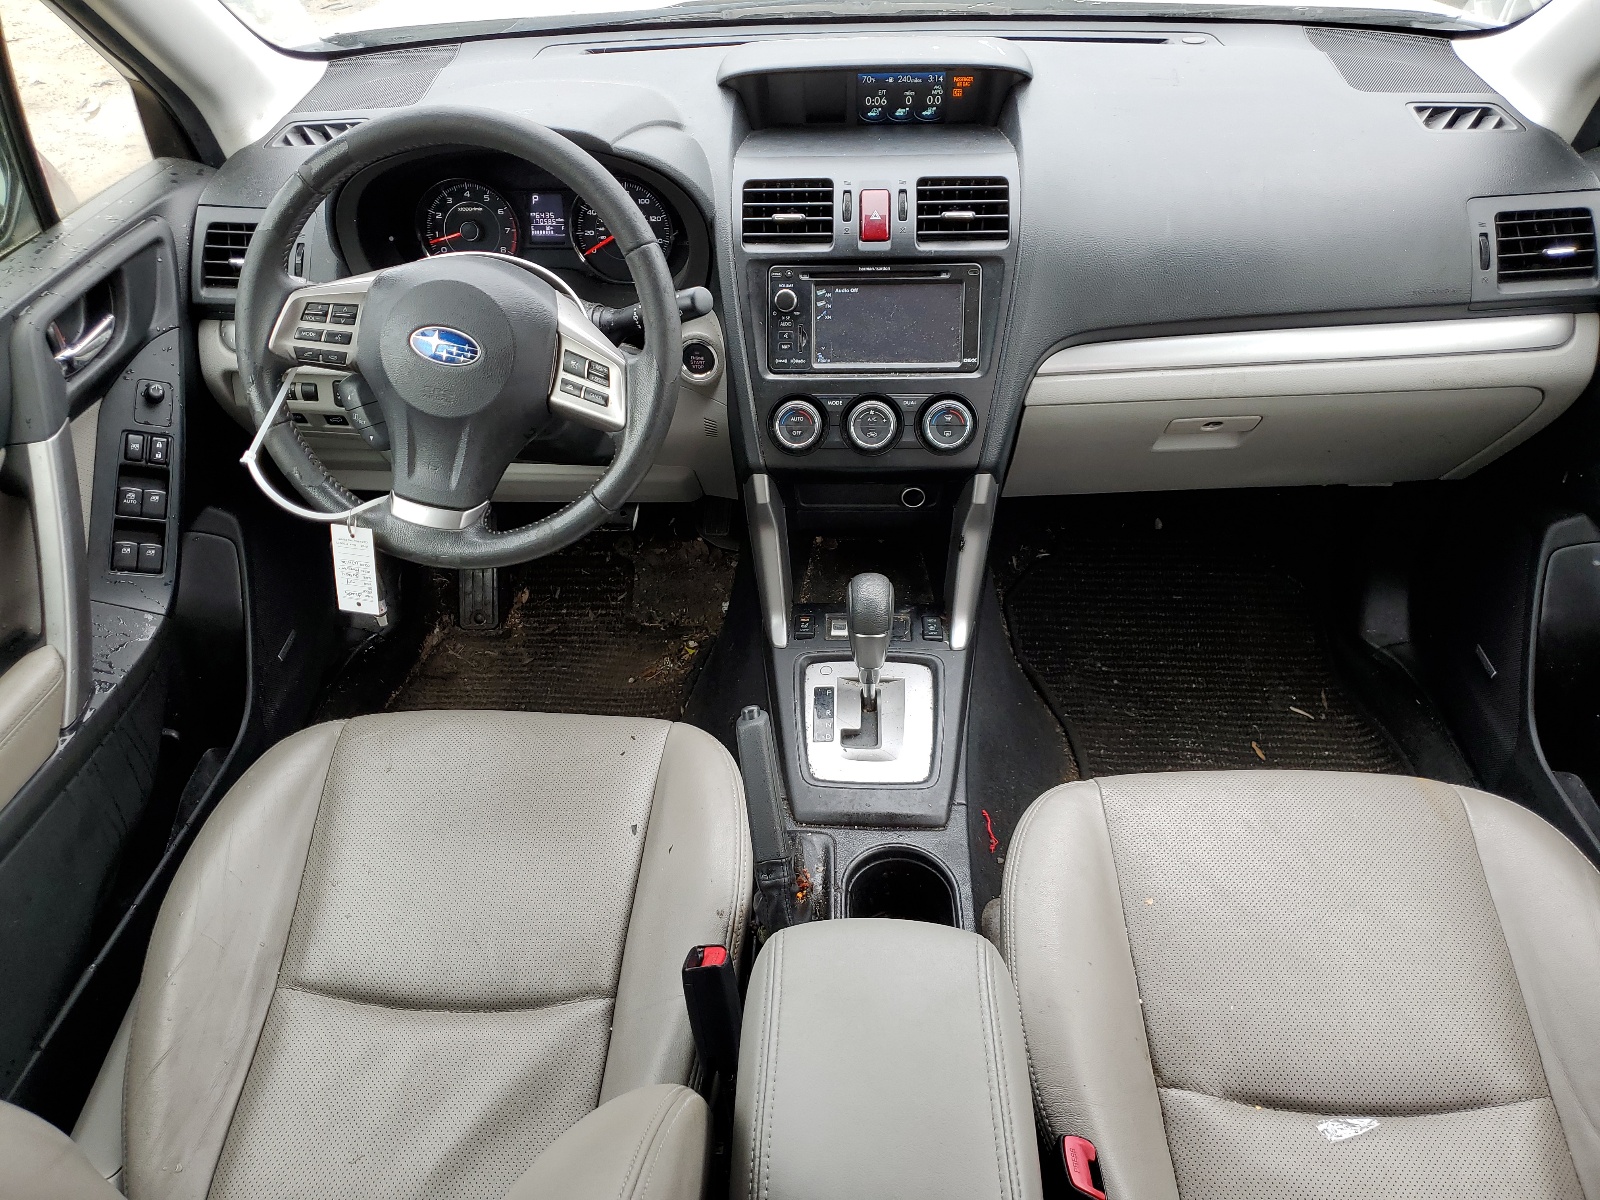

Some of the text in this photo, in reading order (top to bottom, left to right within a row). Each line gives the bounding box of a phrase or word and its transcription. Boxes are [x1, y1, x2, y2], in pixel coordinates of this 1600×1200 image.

[898, 75, 911, 83] 240
[866, 96, 887, 105] 0:06
[906, 96, 912, 104] 0
[926, 96, 942, 104] 0.0
[532, 196, 538, 204] P
[1070, 1148, 1080, 1174] PRESS
